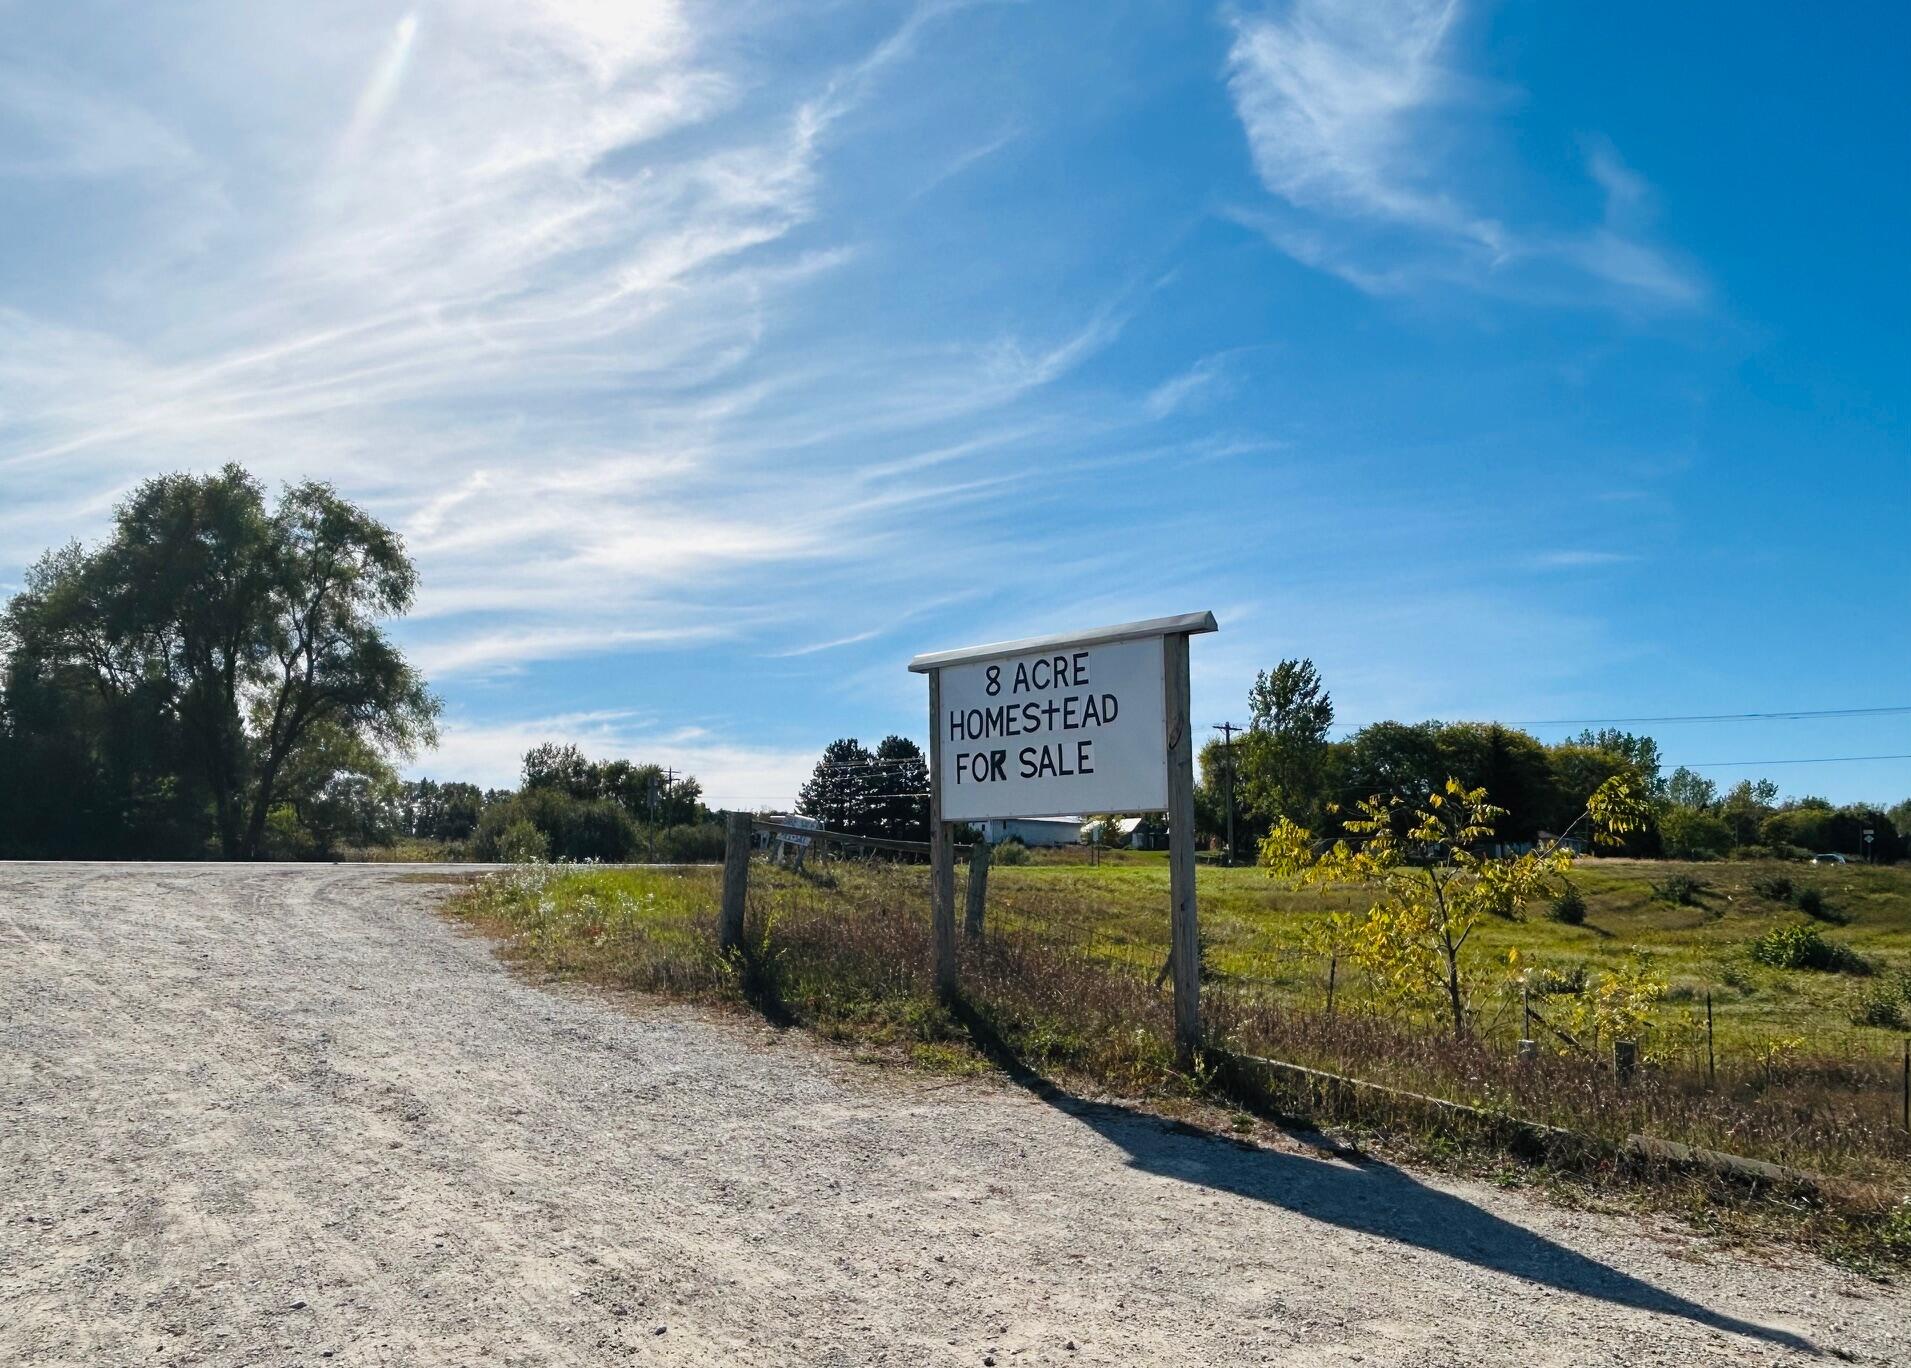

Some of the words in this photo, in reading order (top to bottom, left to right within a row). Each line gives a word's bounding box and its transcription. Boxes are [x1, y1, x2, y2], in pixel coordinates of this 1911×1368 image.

[985, 664, 1003, 697] 8
[1012, 651, 1091, 695] ACRE
[956, 749, 1008, 785] FOR
[1018, 740, 1095, 779] SALE
